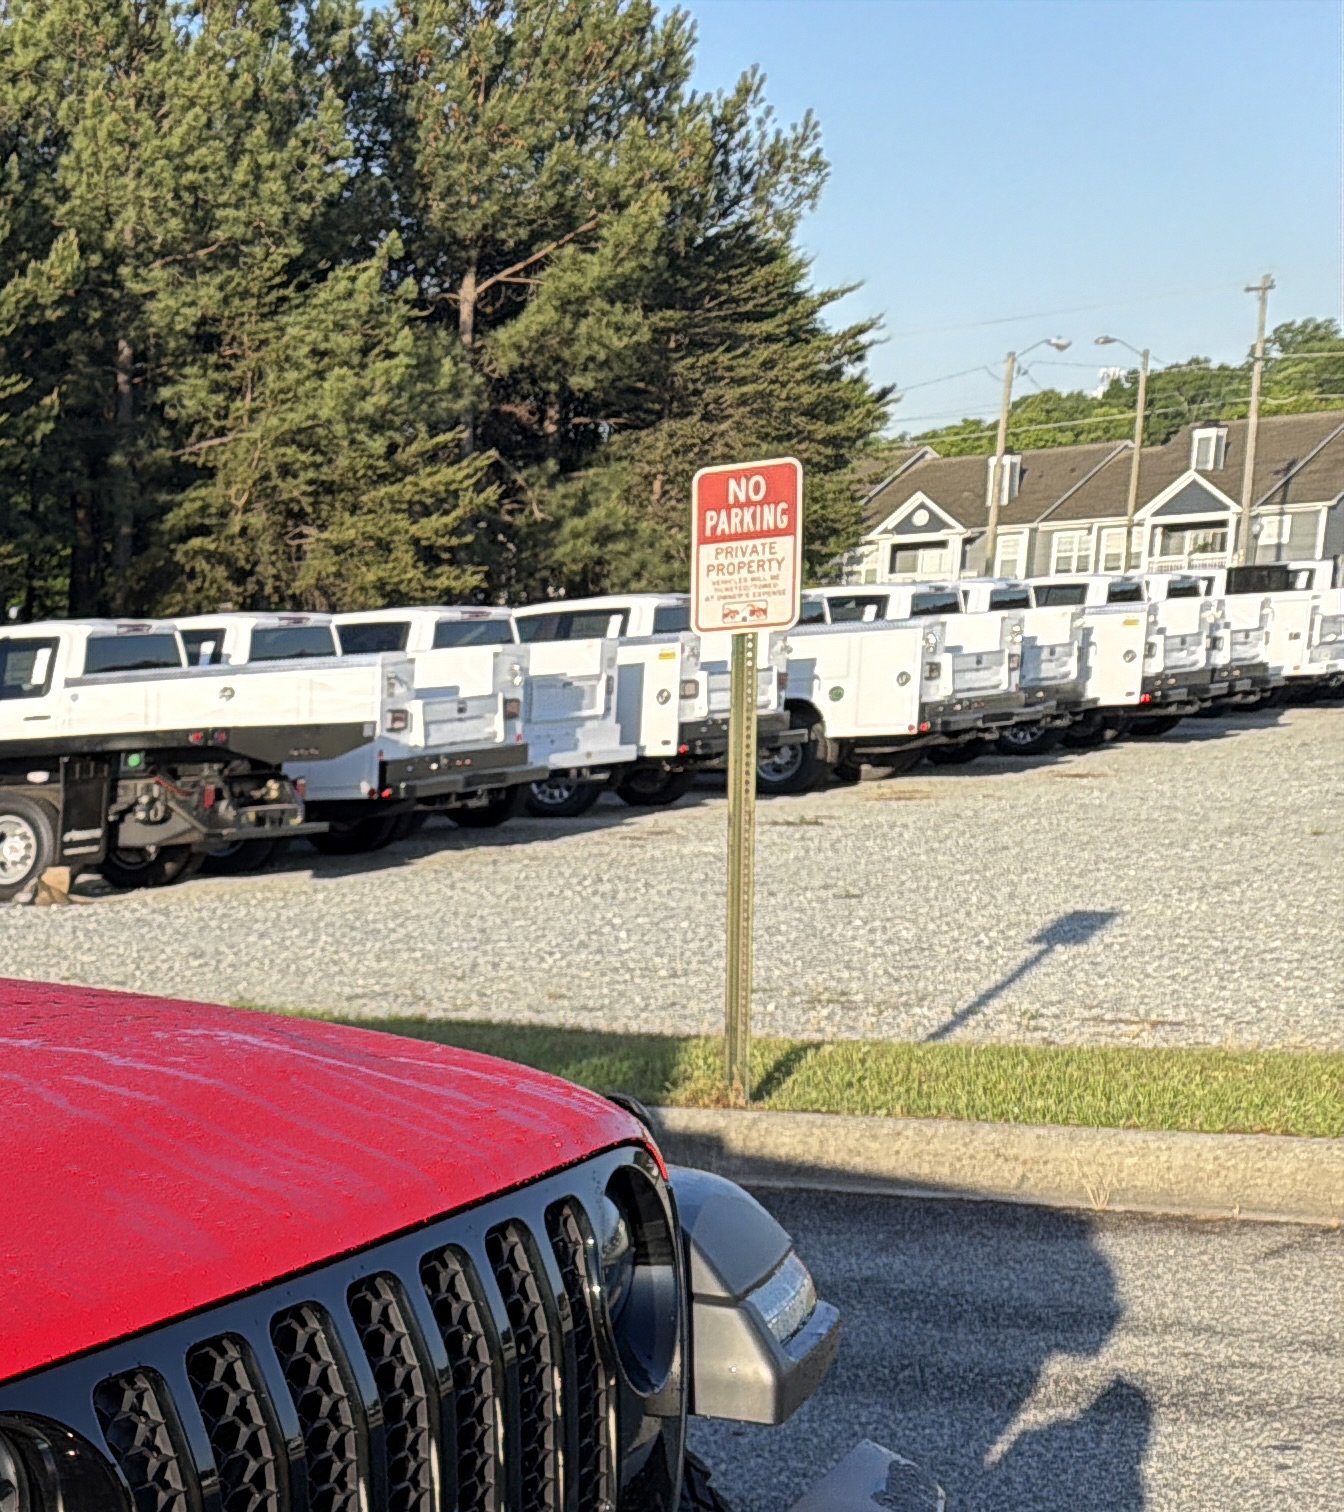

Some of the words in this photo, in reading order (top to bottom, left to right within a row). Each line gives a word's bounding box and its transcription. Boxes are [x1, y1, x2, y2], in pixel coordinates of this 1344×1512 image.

[728, 474, 767, 504] NO
[705, 502, 789, 537] PARKING
[715, 541, 778, 561] PRIVATE
[706, 557, 786, 577] PROPERTY
